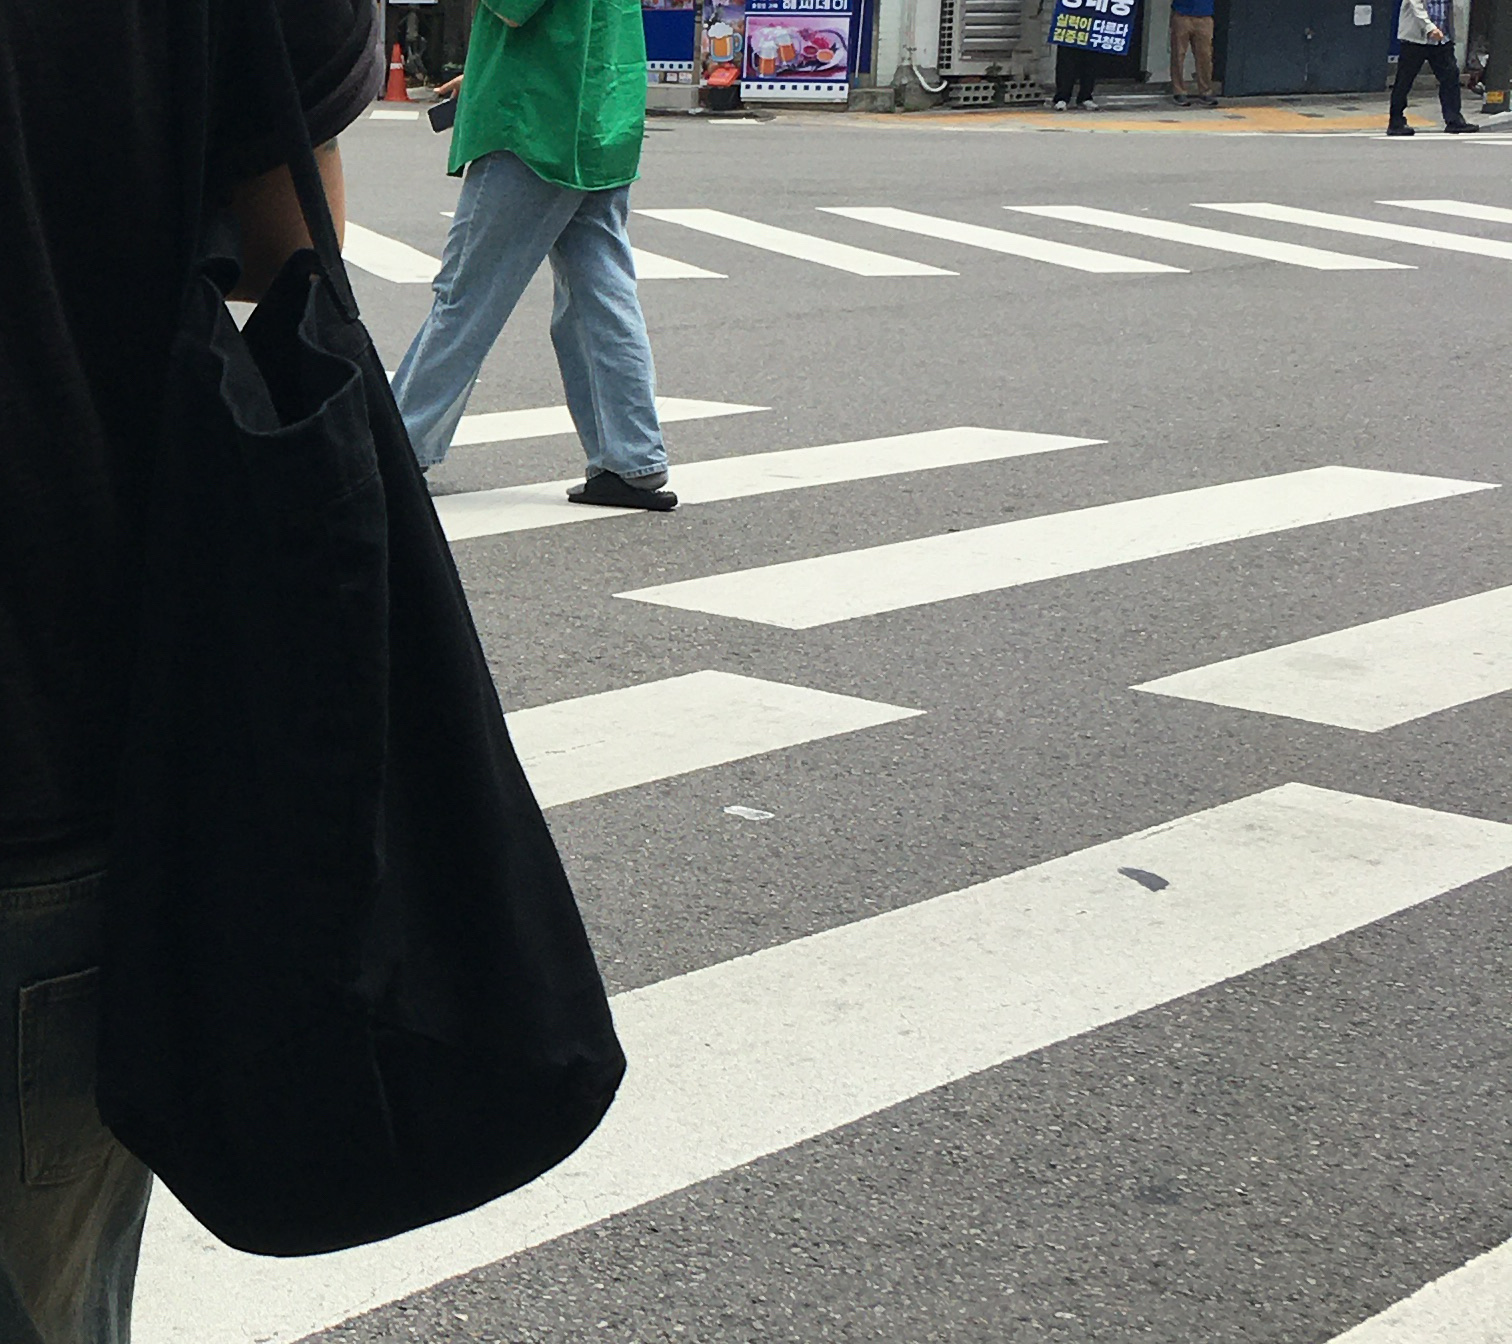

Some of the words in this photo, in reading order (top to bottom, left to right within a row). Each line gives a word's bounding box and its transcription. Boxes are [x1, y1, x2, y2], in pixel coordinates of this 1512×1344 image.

[1056, 13, 1093, 31] 실력이
[1092, 19, 1129, 37] 다르다
[1053, 27, 1090, 46] 검증된
[1089, 33, 1126, 52] 구청장
